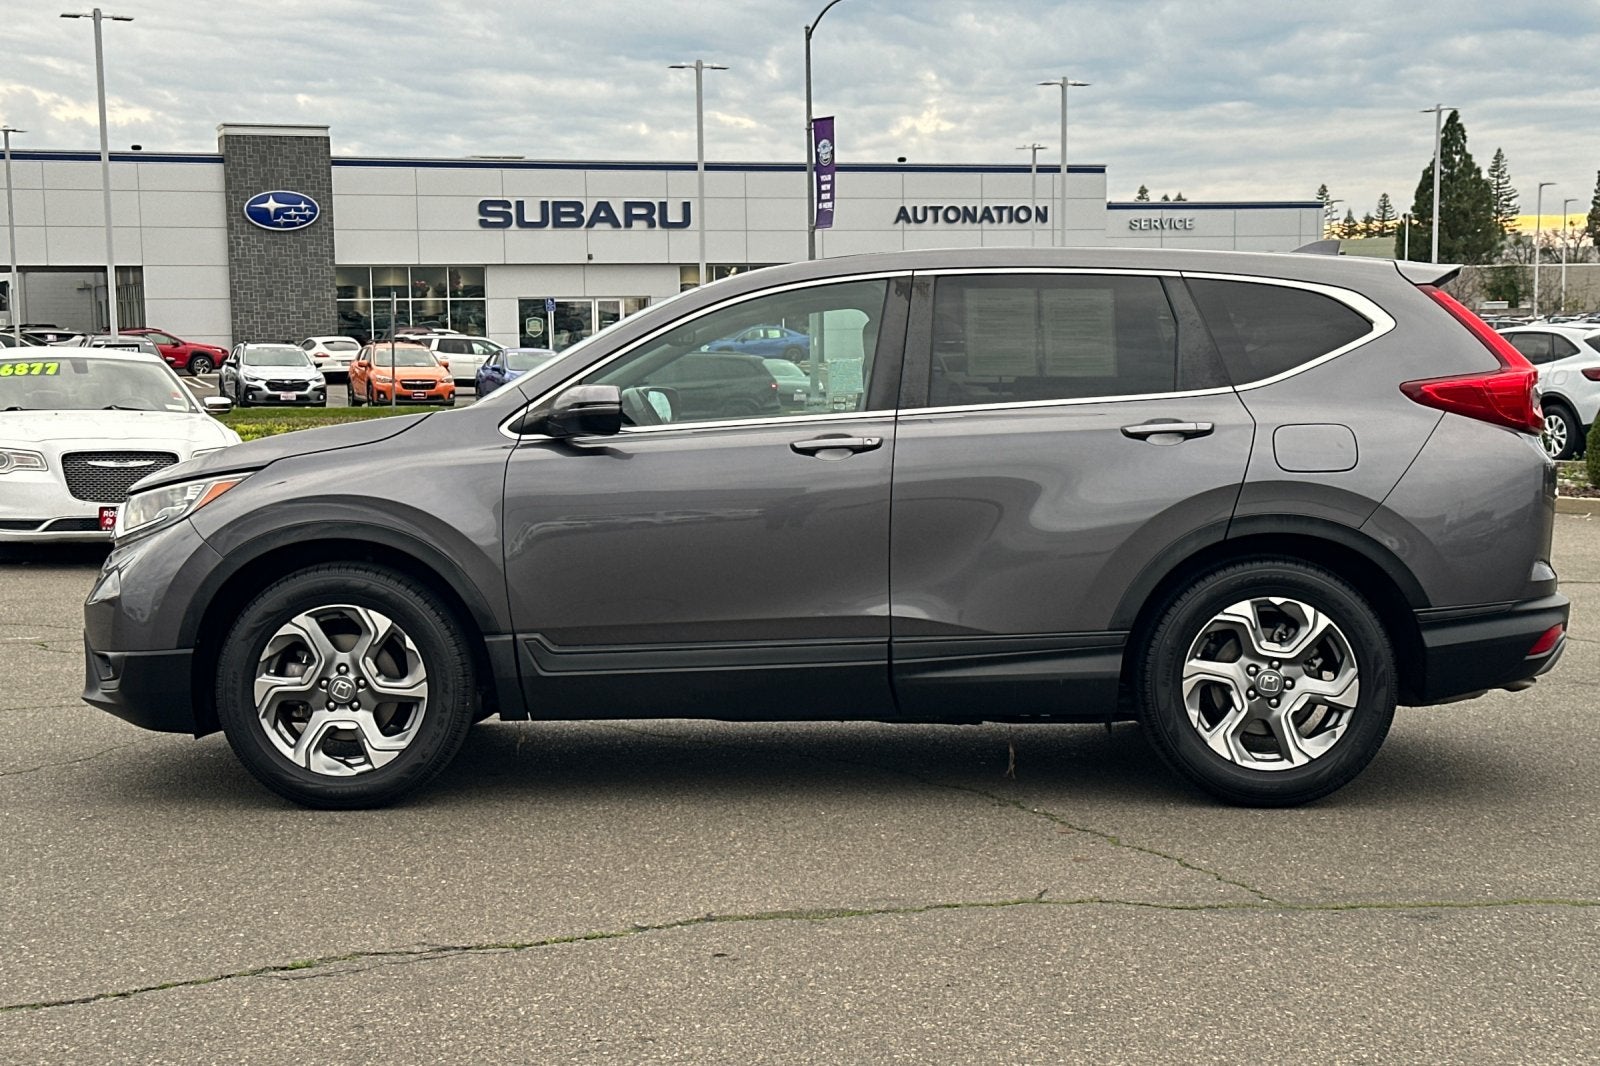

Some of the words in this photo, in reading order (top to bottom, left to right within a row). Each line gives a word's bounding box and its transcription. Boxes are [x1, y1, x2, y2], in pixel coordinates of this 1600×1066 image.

[478, 199, 692, 229] SUBARU
[893, 205, 1049, 224] AUTONATION
[1129, 217, 1195, 230] SERVICE
[0, 362, 59, 377] 6877
